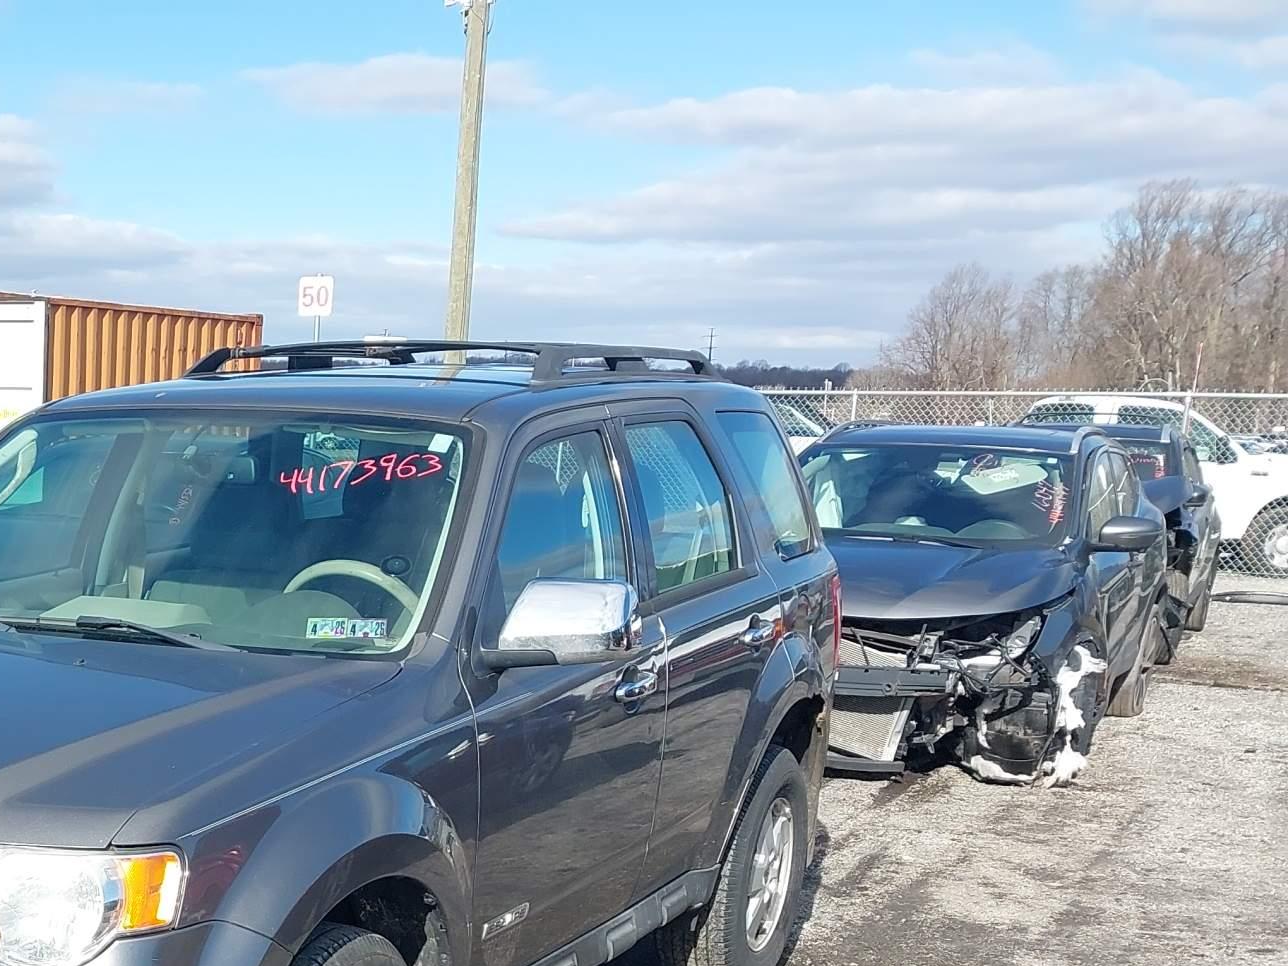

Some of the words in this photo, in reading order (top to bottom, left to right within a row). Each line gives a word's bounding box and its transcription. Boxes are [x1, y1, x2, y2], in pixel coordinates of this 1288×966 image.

[302, 286, 329, 307] 50
[279, 453, 443, 494] 44173963
[310, 623, 318, 636] 4
[349, 623, 357, 636] 4
